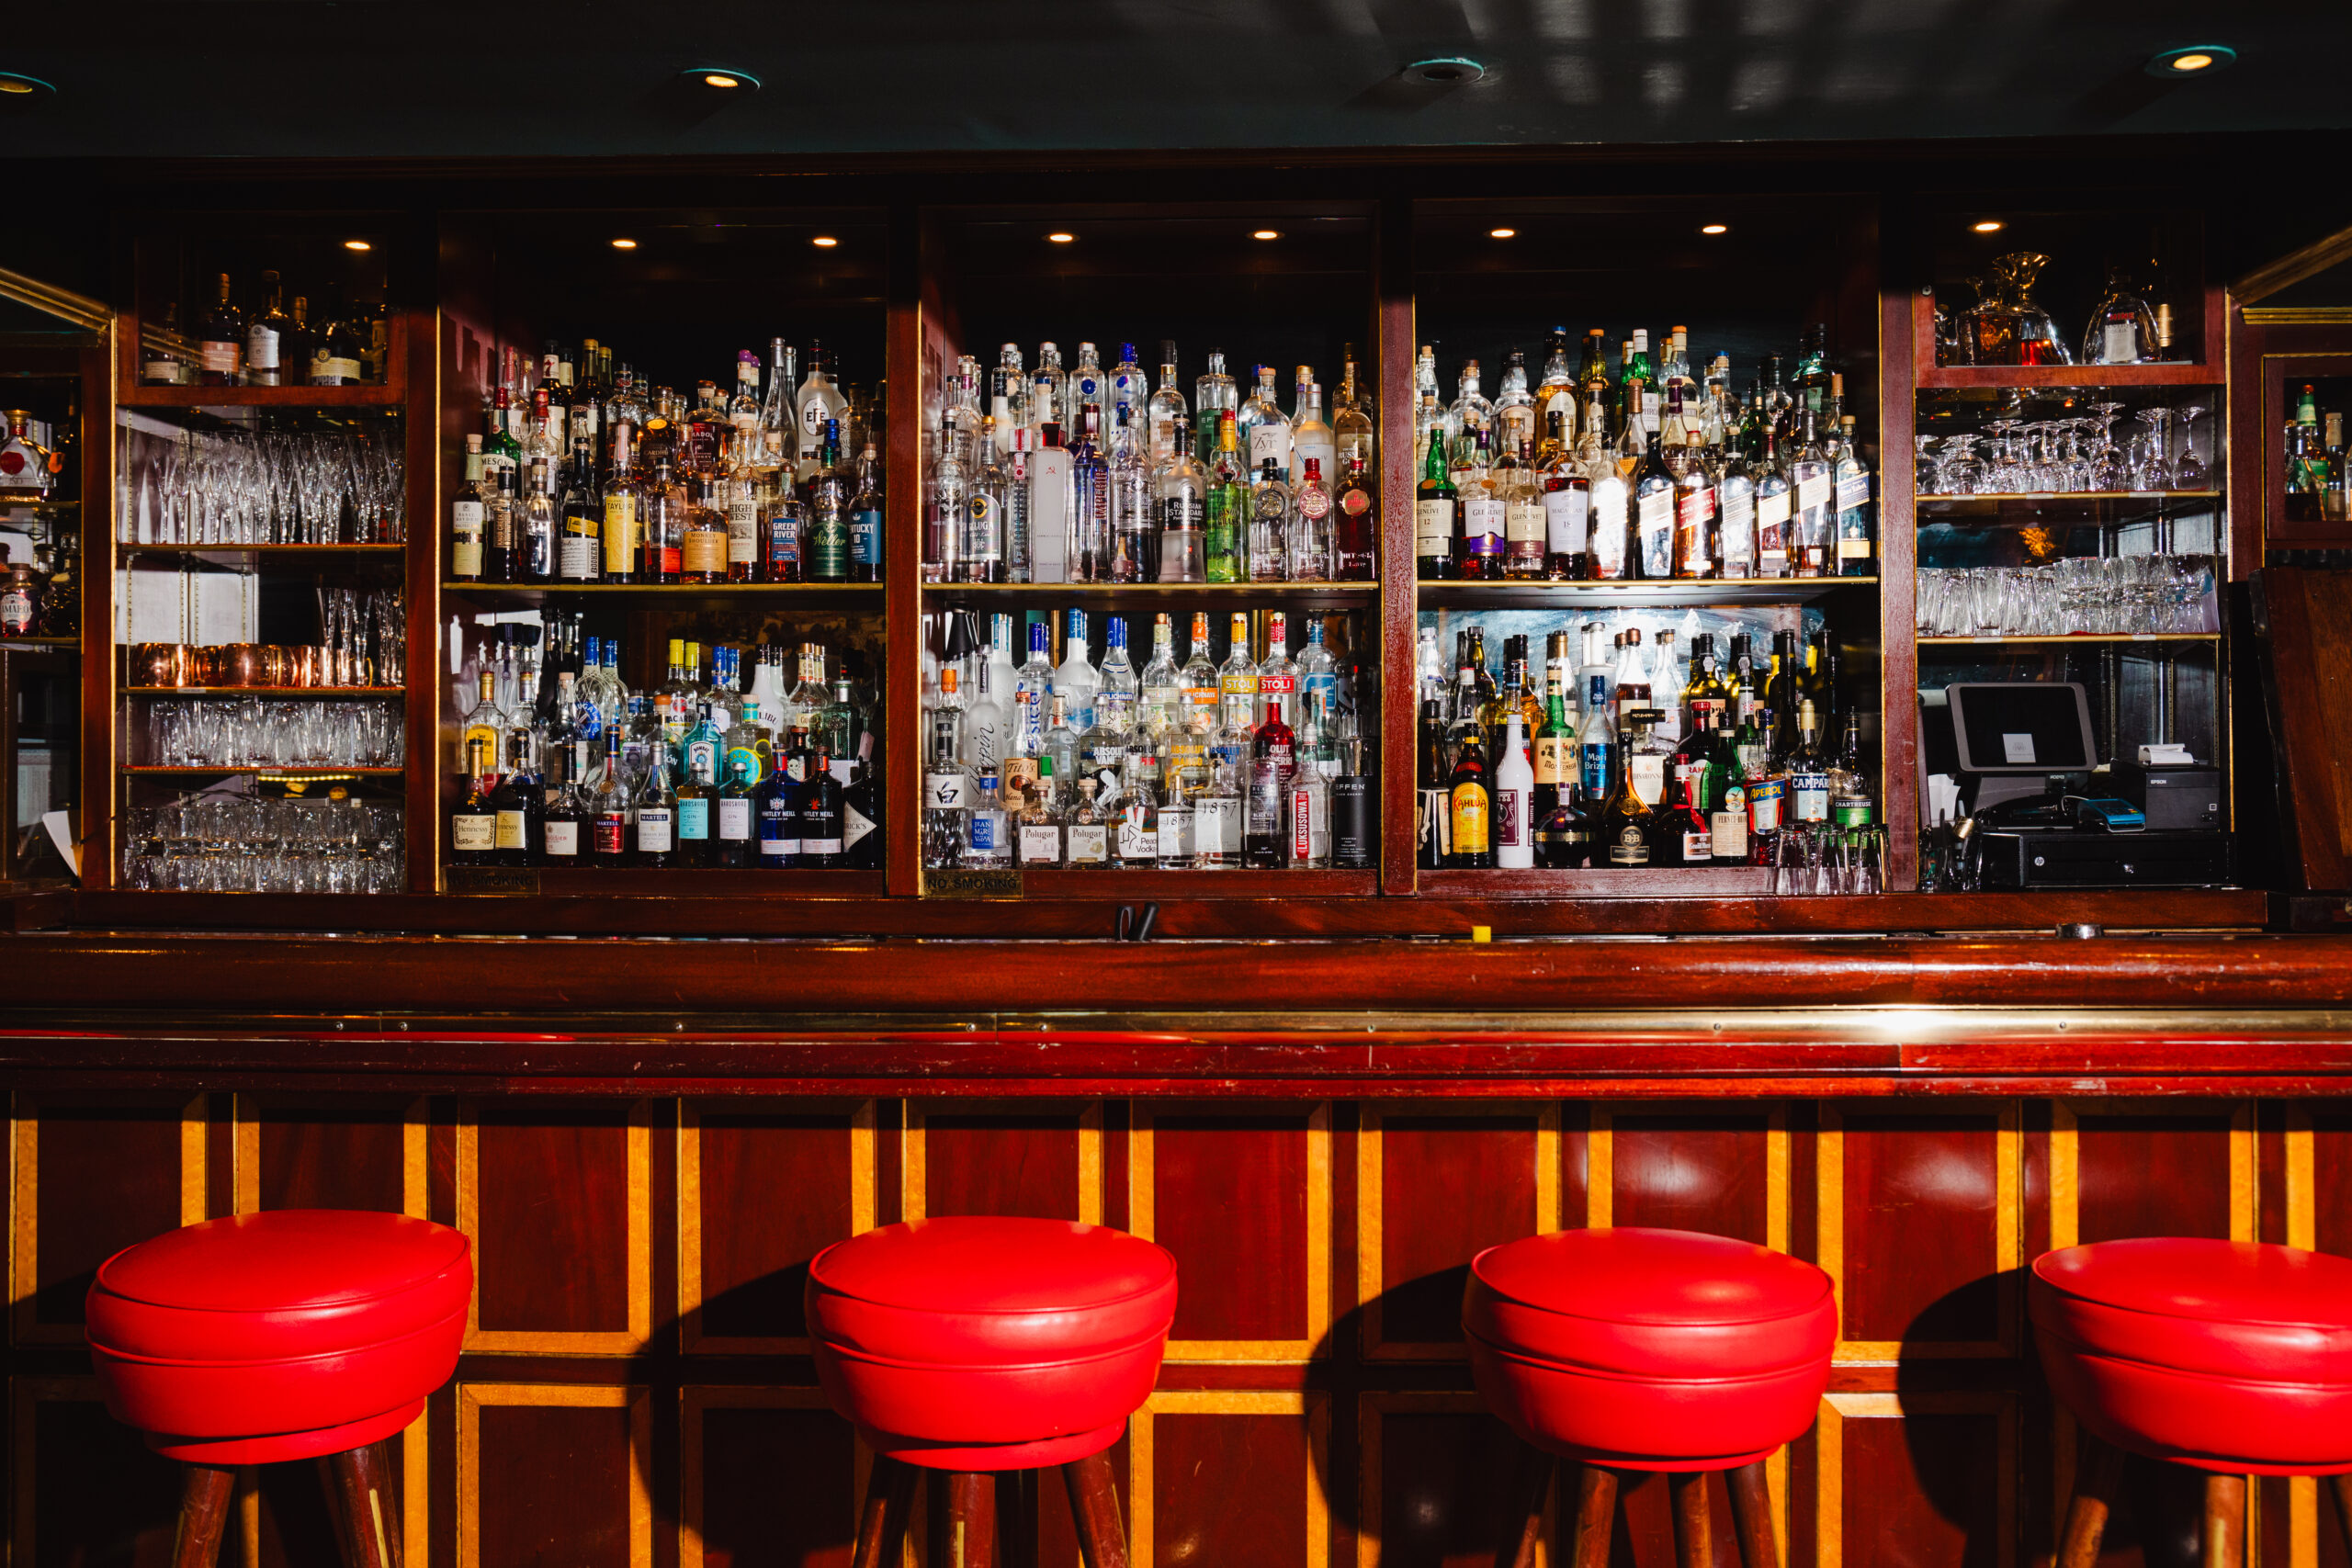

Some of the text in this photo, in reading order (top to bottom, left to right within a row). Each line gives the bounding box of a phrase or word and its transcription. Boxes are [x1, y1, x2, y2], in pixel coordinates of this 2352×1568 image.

[481, 457, 510, 467] MESON
[773, 522, 797, 531] GREEN
[774, 530, 796, 539] RIVER
[1226, 678, 1256, 690] STOLI
[1261, 679, 1290, 690] STOLI
[668, 715, 695, 723] ACARDI
[758, 711, 778, 725] LIBU
[1170, 745, 1204, 754] ABSOLUT
[1270, 744, 1291, 754] OLUT
[1587, 752, 1607, 761] Mari
[1007, 762, 1035, 773] Tito's
[1584, 761, 1606, 770] Briza
[1792, 777, 1829, 789] CAMPAR
[1749, 785, 1782, 800] APEROL
[1203, 801, 1238, 818] 1857
[1453, 796, 1487, 812] KAHLÚA
[497, 824, 518, 832] nnessy
[1297, 800, 1308, 851] LUKSUSOWA
[1025, 828, 1056, 840] Polugar
[1073, 828, 1103, 840] Polugar
[472, 874, 535, 886] SMOKING
[927, 877, 1018, 889] NO SMOKING
